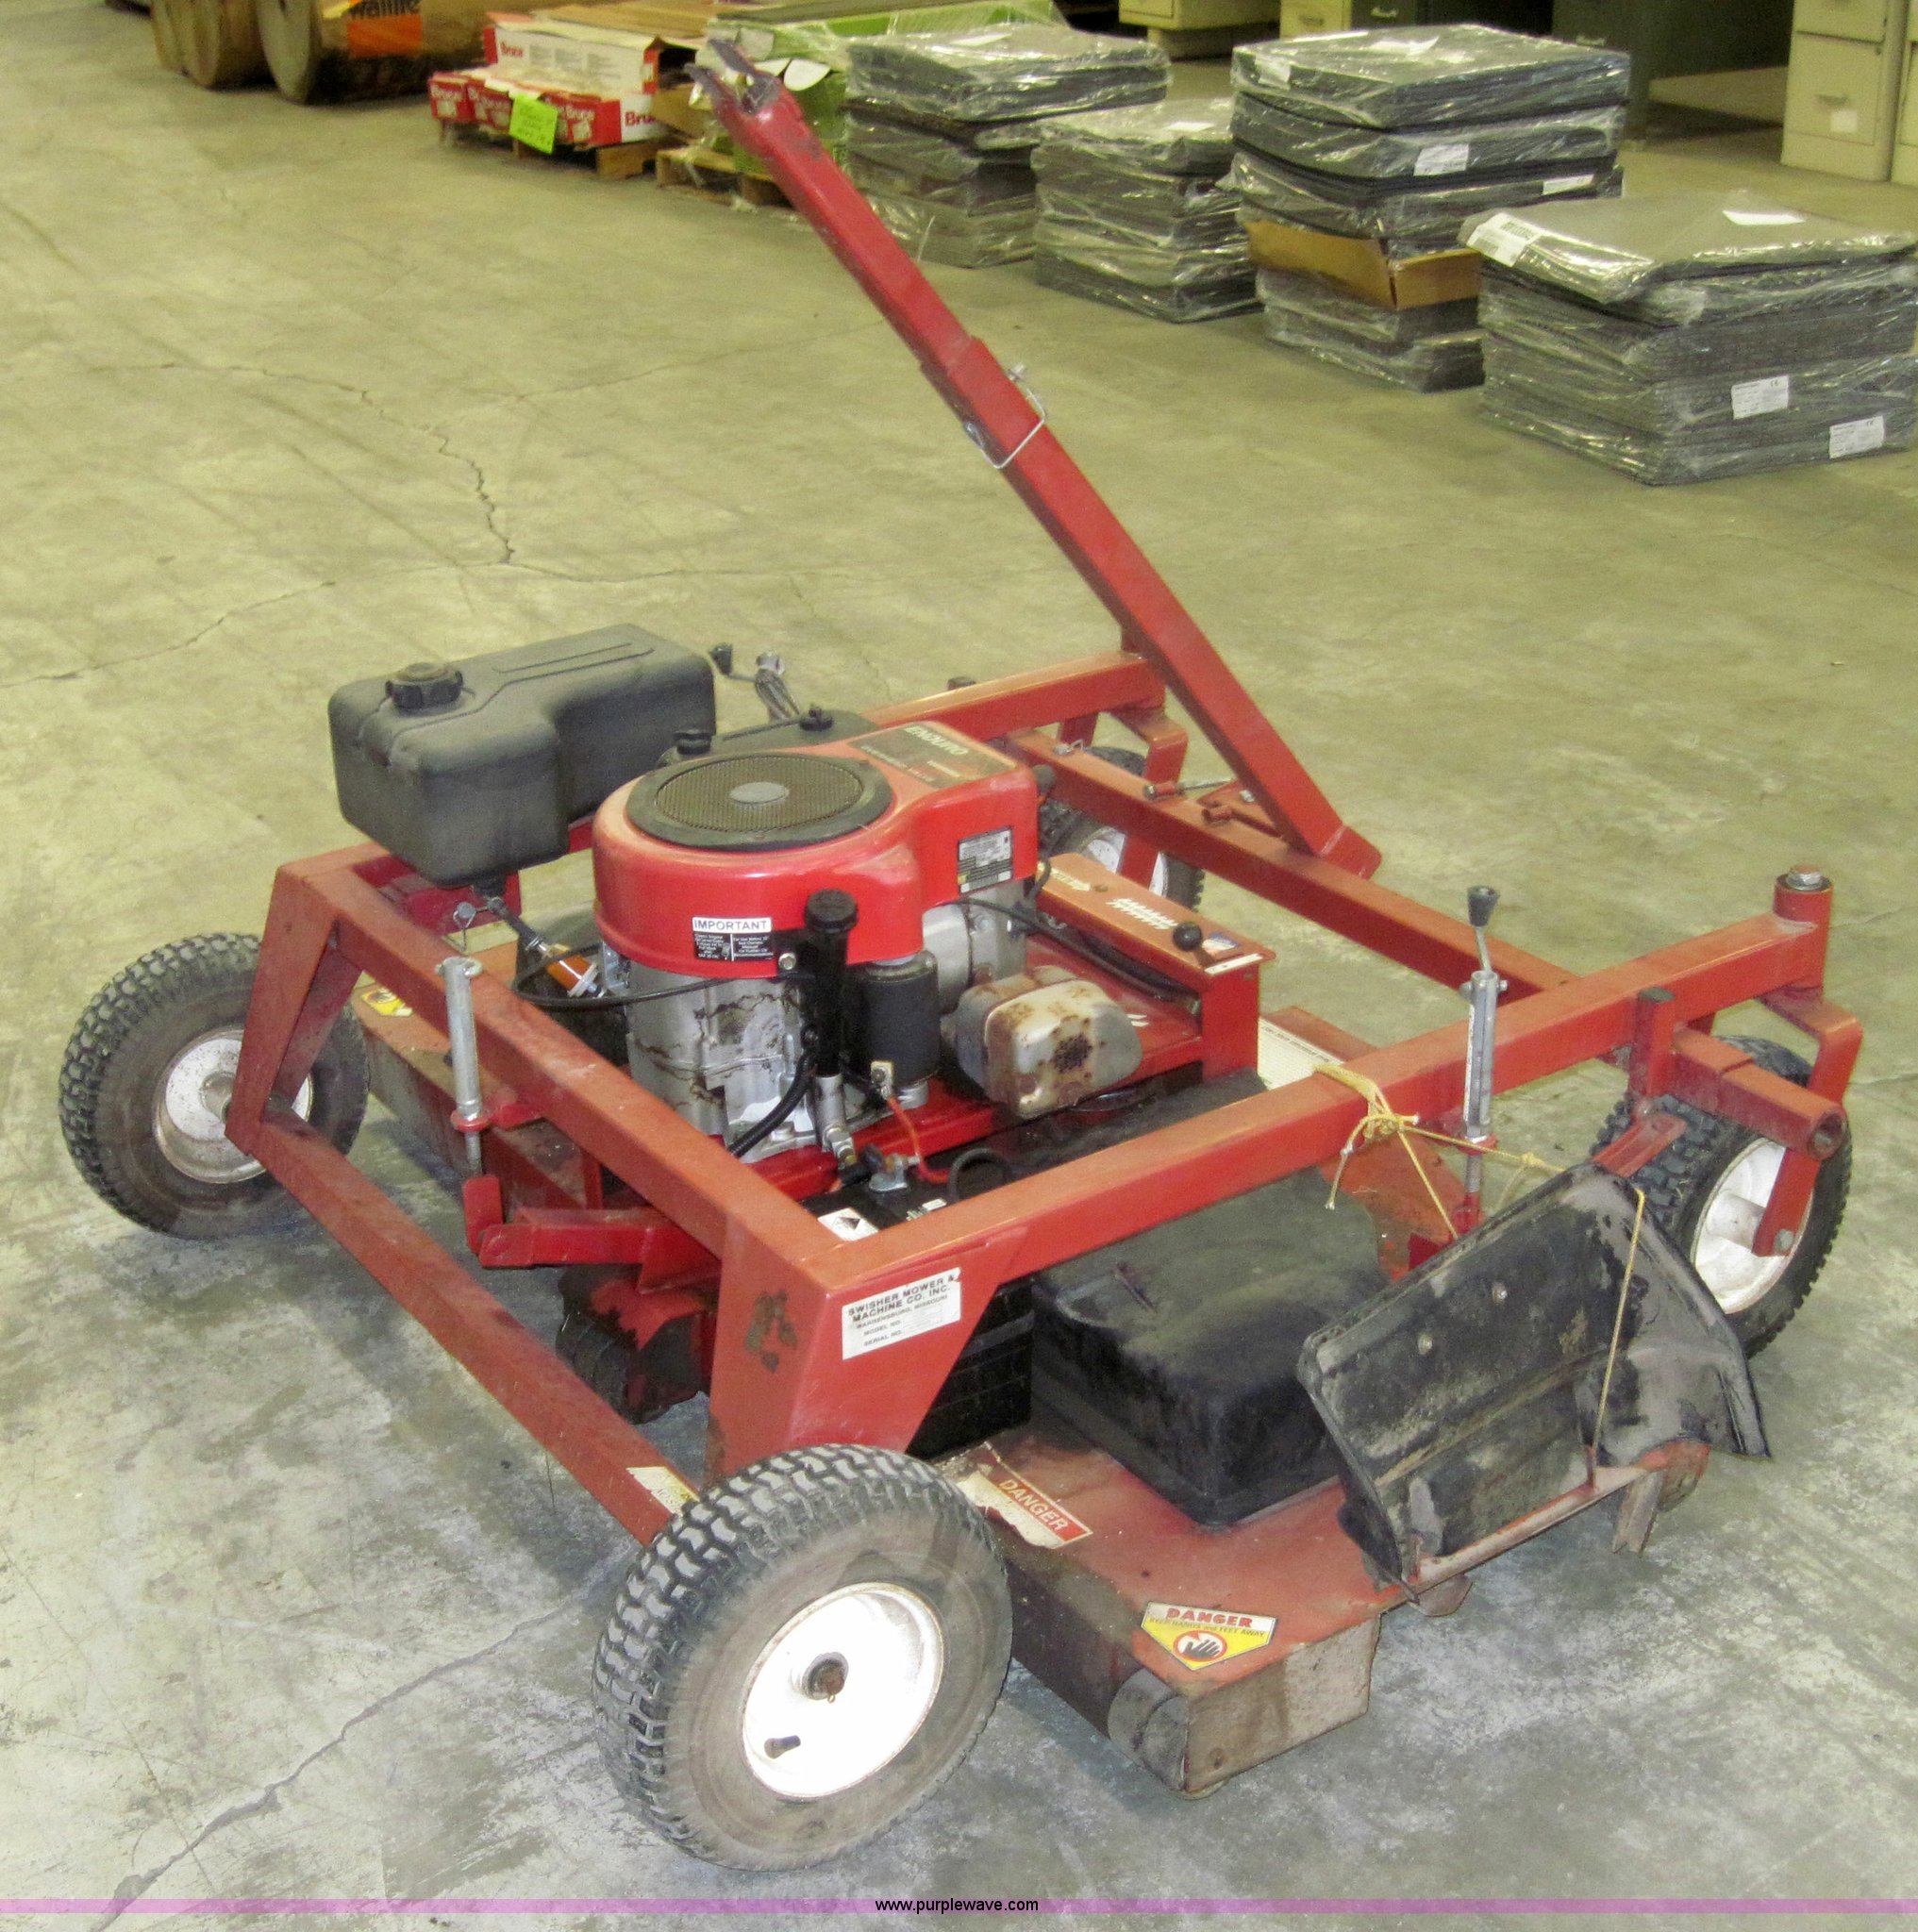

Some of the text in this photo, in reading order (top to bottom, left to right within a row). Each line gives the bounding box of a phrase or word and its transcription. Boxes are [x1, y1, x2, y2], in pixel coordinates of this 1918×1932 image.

[693, 920, 768, 931] IMPORTANT
[848, 1292, 899, 1316] SWISHER
[903, 1277, 944, 1297] MOWER
[852, 1284, 951, 1323] MACHINE CO. INC.
[999, 1478, 1069, 1532] DANGER
[1166, 1607, 1254, 1629] DANGER
[1241, 1628, 1265, 1639] AWAY
